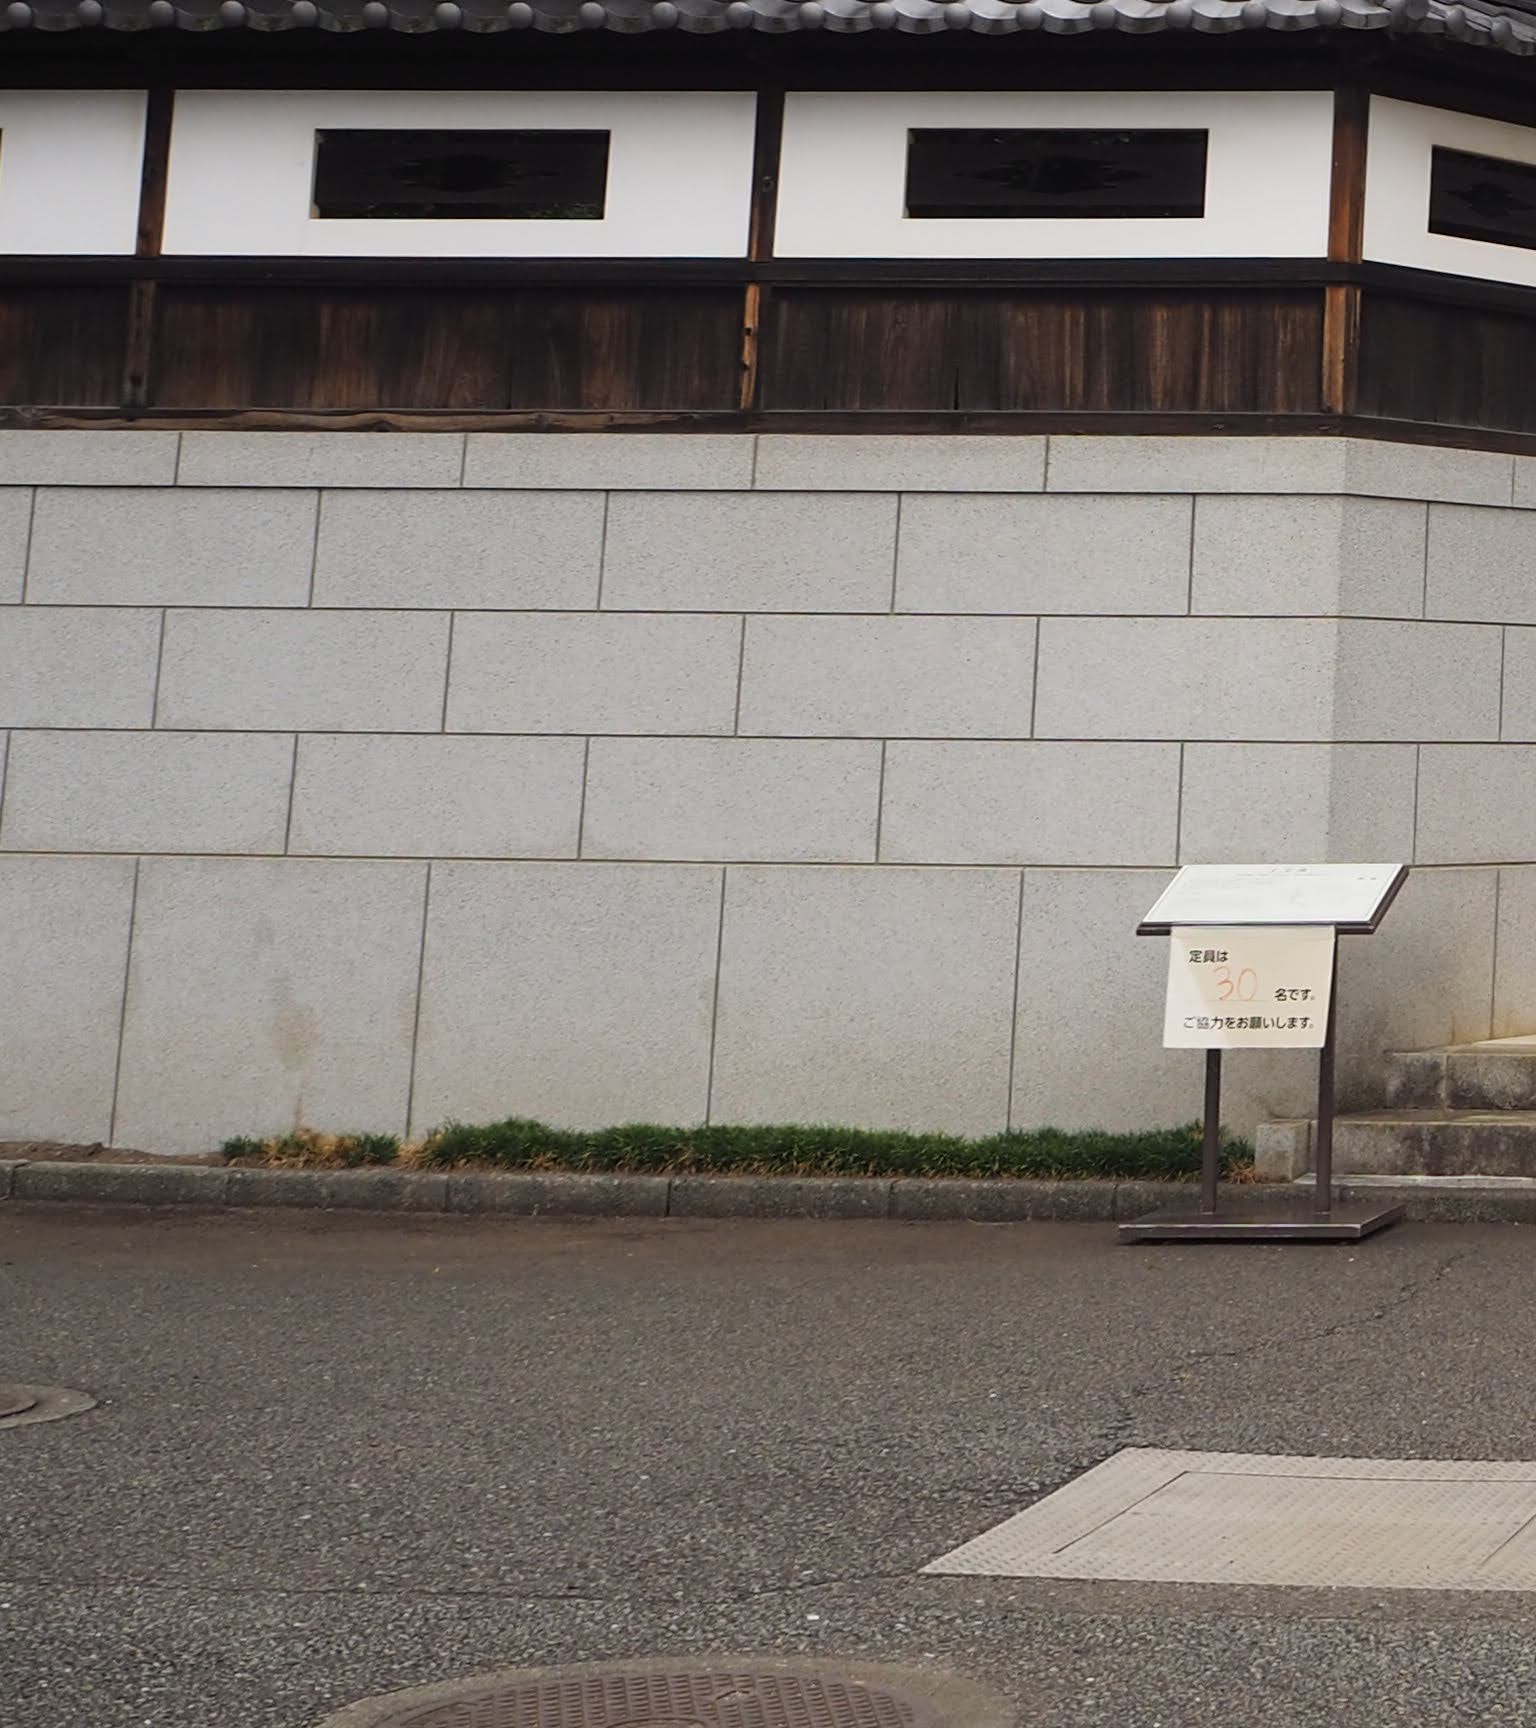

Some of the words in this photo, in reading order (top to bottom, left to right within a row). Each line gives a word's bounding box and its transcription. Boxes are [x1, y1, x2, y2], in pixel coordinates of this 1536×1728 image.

[1188, 949, 1229, 963] 定員は
[1213, 965, 1258, 1001] 30
[1274, 988, 1316, 1001] 名です。
